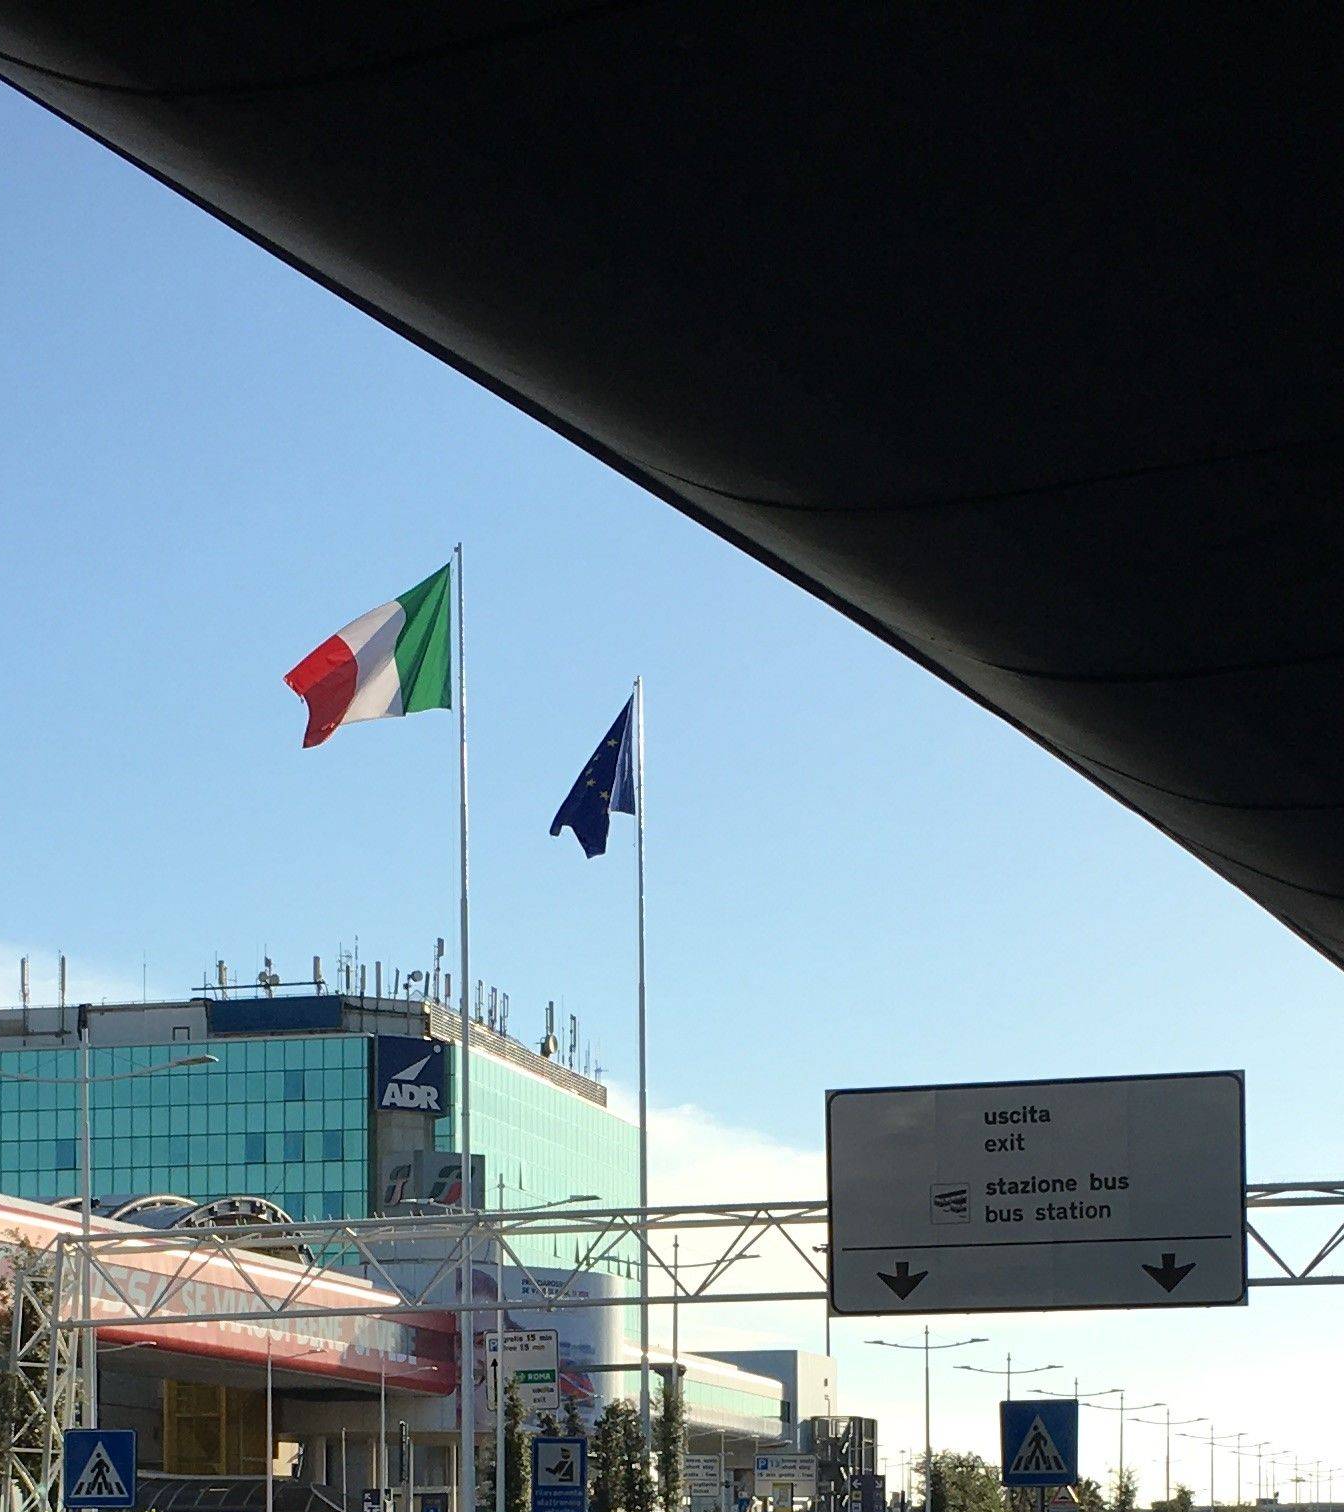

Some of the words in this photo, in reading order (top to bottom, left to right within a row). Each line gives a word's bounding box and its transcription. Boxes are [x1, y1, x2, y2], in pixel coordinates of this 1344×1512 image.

[382, 1082, 441, 1111] ADR
[984, 1105, 1051, 1125] uscita
[984, 1133, 1025, 1153] exit
[985, 1175, 1077, 1196] stazione
[1089, 1172, 1129, 1191] bus
[985, 1204, 1023, 1223] bus
[1035, 1200, 1111, 1221] station
[526, 1334, 536, 1342] 15
[527, 1372, 551, 1381] ROMA
